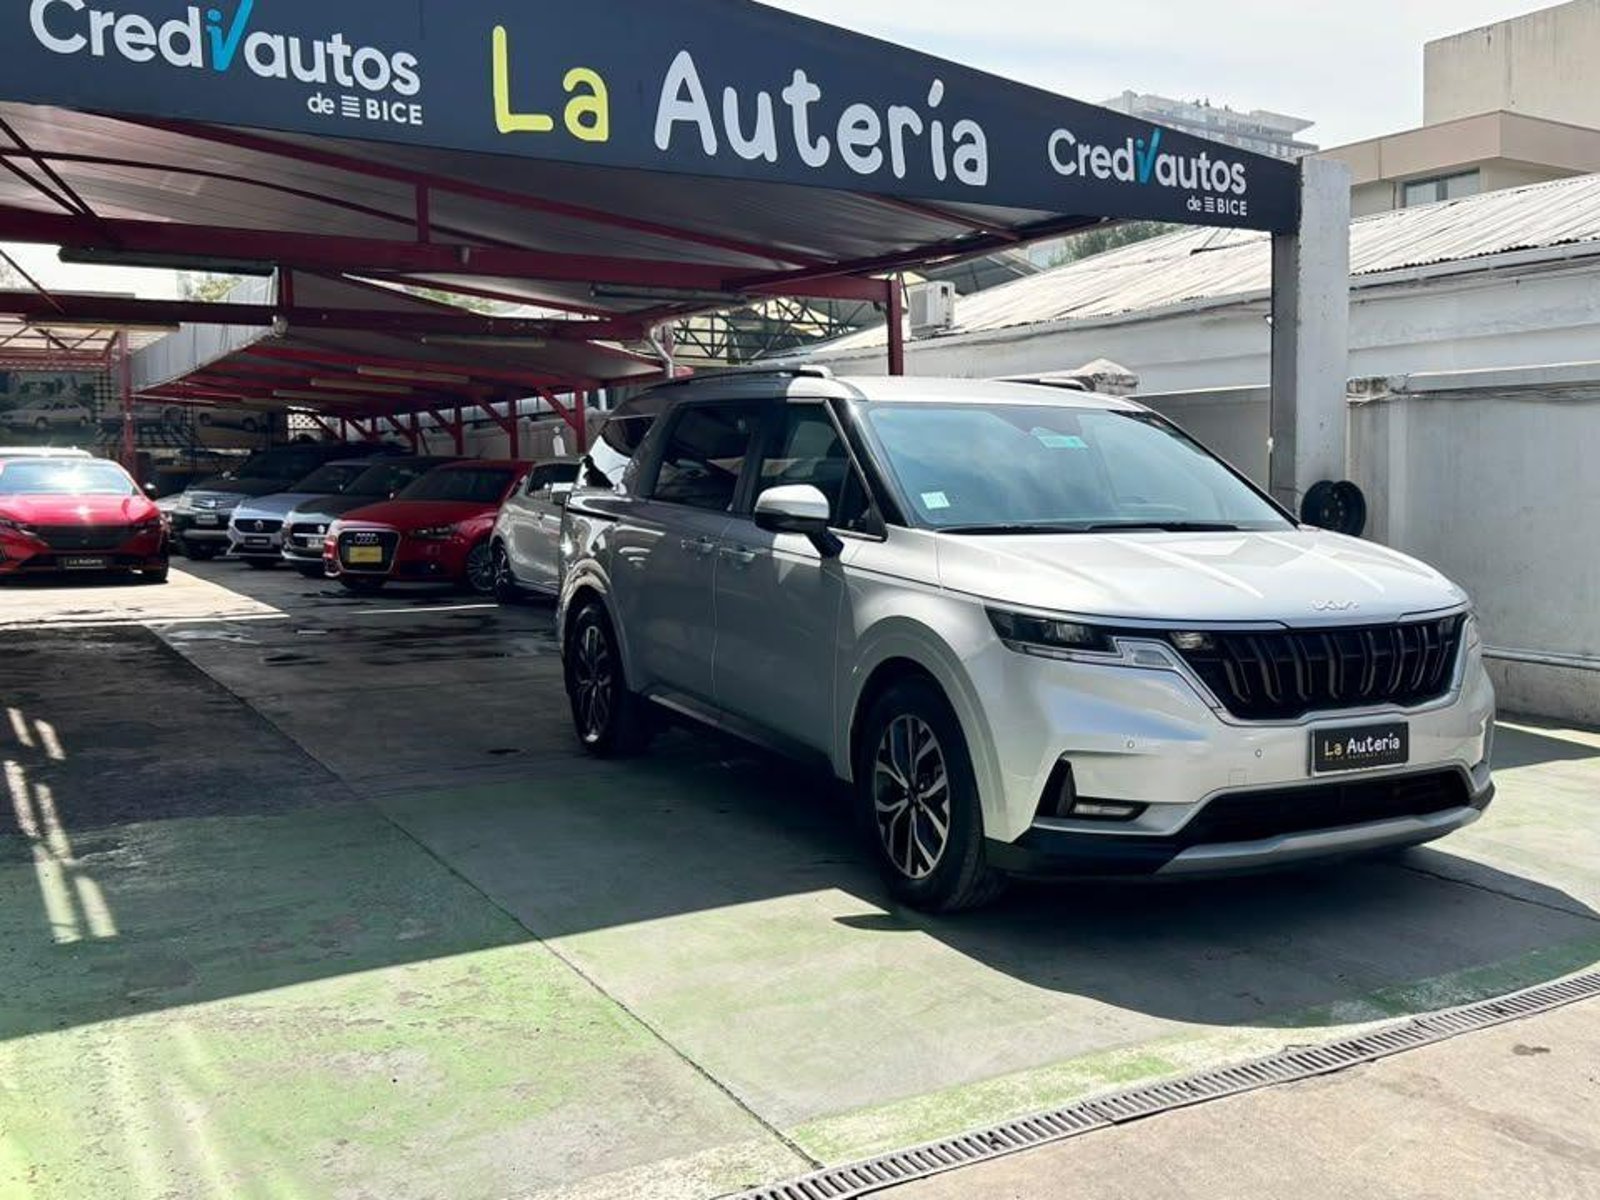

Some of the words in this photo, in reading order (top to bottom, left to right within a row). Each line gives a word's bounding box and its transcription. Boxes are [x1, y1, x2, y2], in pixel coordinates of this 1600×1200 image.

[307, 93, 335, 115] de
[365, 98, 423, 125] BICE
[492, 26, 609, 142] La
[654, 50, 990, 187] Autería
[1186, 196, 1201, 211] de
[1217, 198, 1247, 216] BICE
[1324, 740, 1342, 756] La
[1346, 732, 1400, 754] Autería
